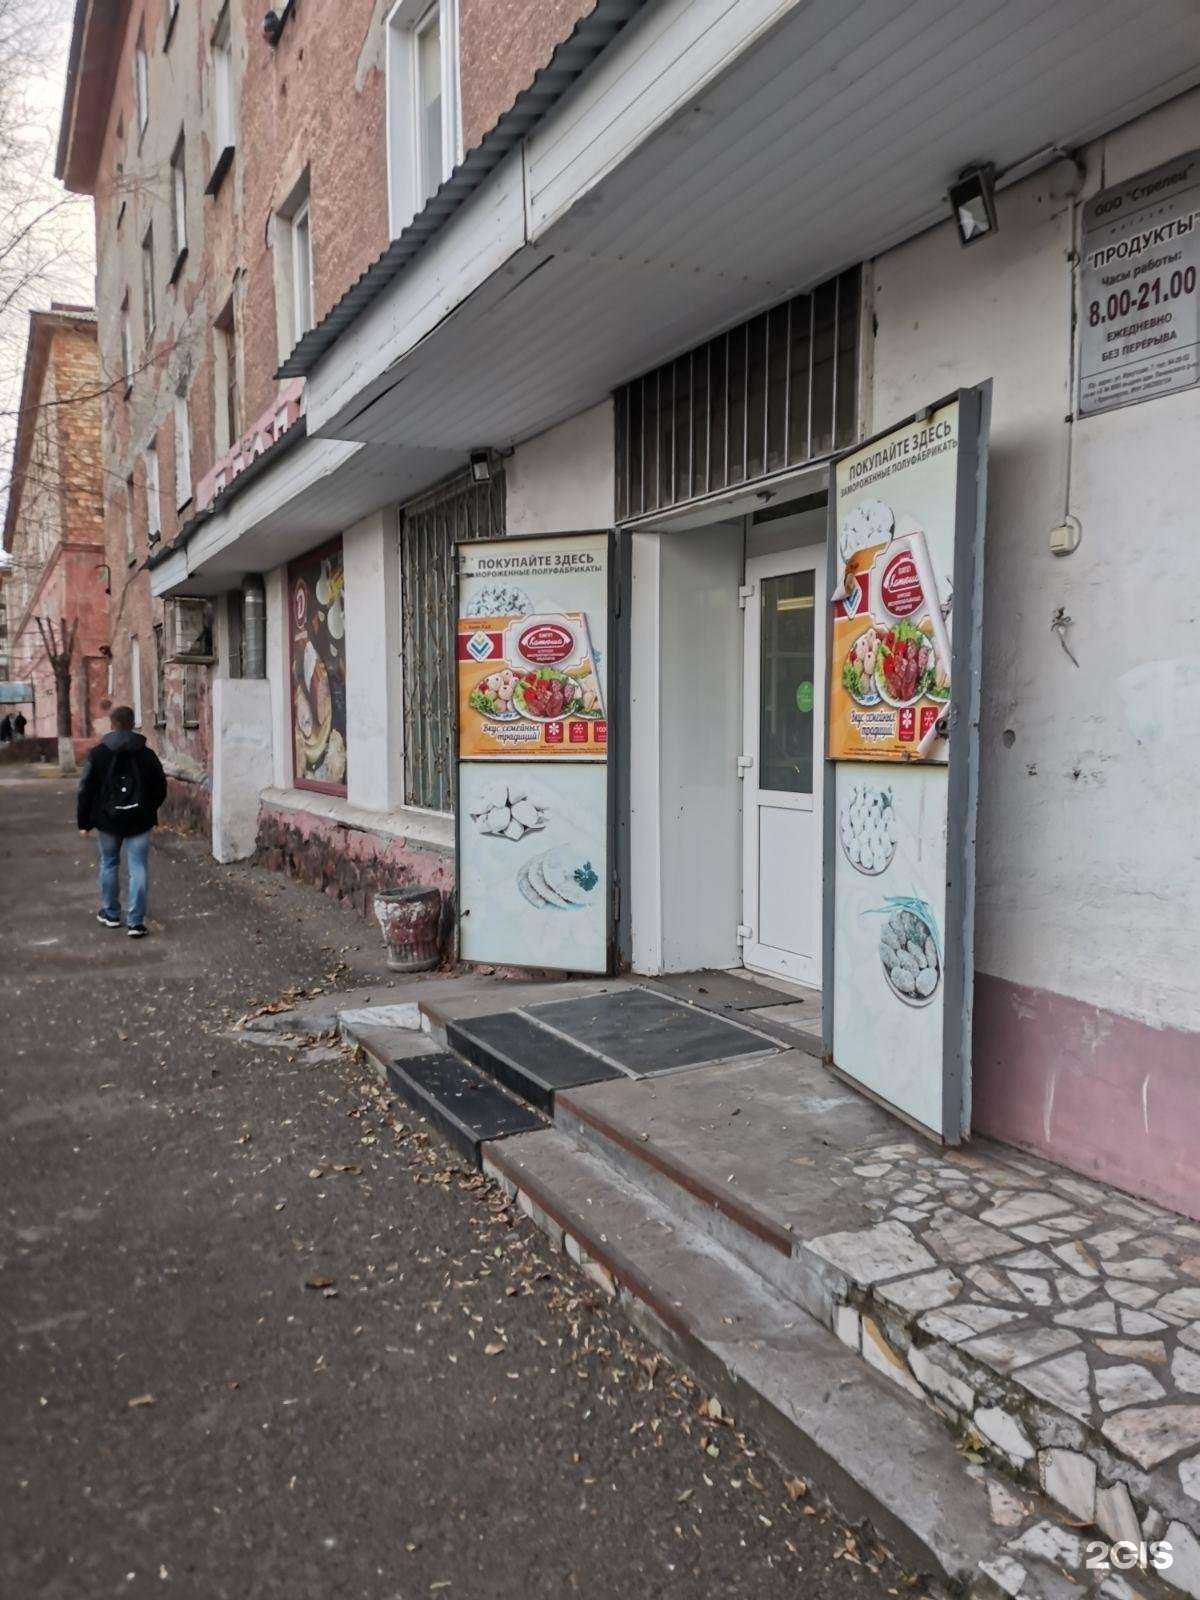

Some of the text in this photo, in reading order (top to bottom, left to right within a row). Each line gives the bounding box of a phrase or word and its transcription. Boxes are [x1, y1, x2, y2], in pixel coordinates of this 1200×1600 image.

[1094, 196, 1122, 217] ООО
[1102, 251, 1182, 286] Часы работы:
[1089, 265, 1196, 327] 8.00-21.00
[1107, 312, 1172, 342] ЕЖЕДНЕВНО
[1102, 330, 1178, 362] БЕЗ ПЕРЕРЫВА
[849, 420, 952, 480] ПОКУПАЙТЕ ЗДЕСЬ
[840, 466, 891, 498] ЗАМОРОЖЕННЫЕ
[474, 566, 602, 578] МОРОЖЕННЫЕ ПОЛУФАБРИКАТЫ
[478, 553, 594, 570] ПОКУПАЙТЕ ЗДЕСЬ
